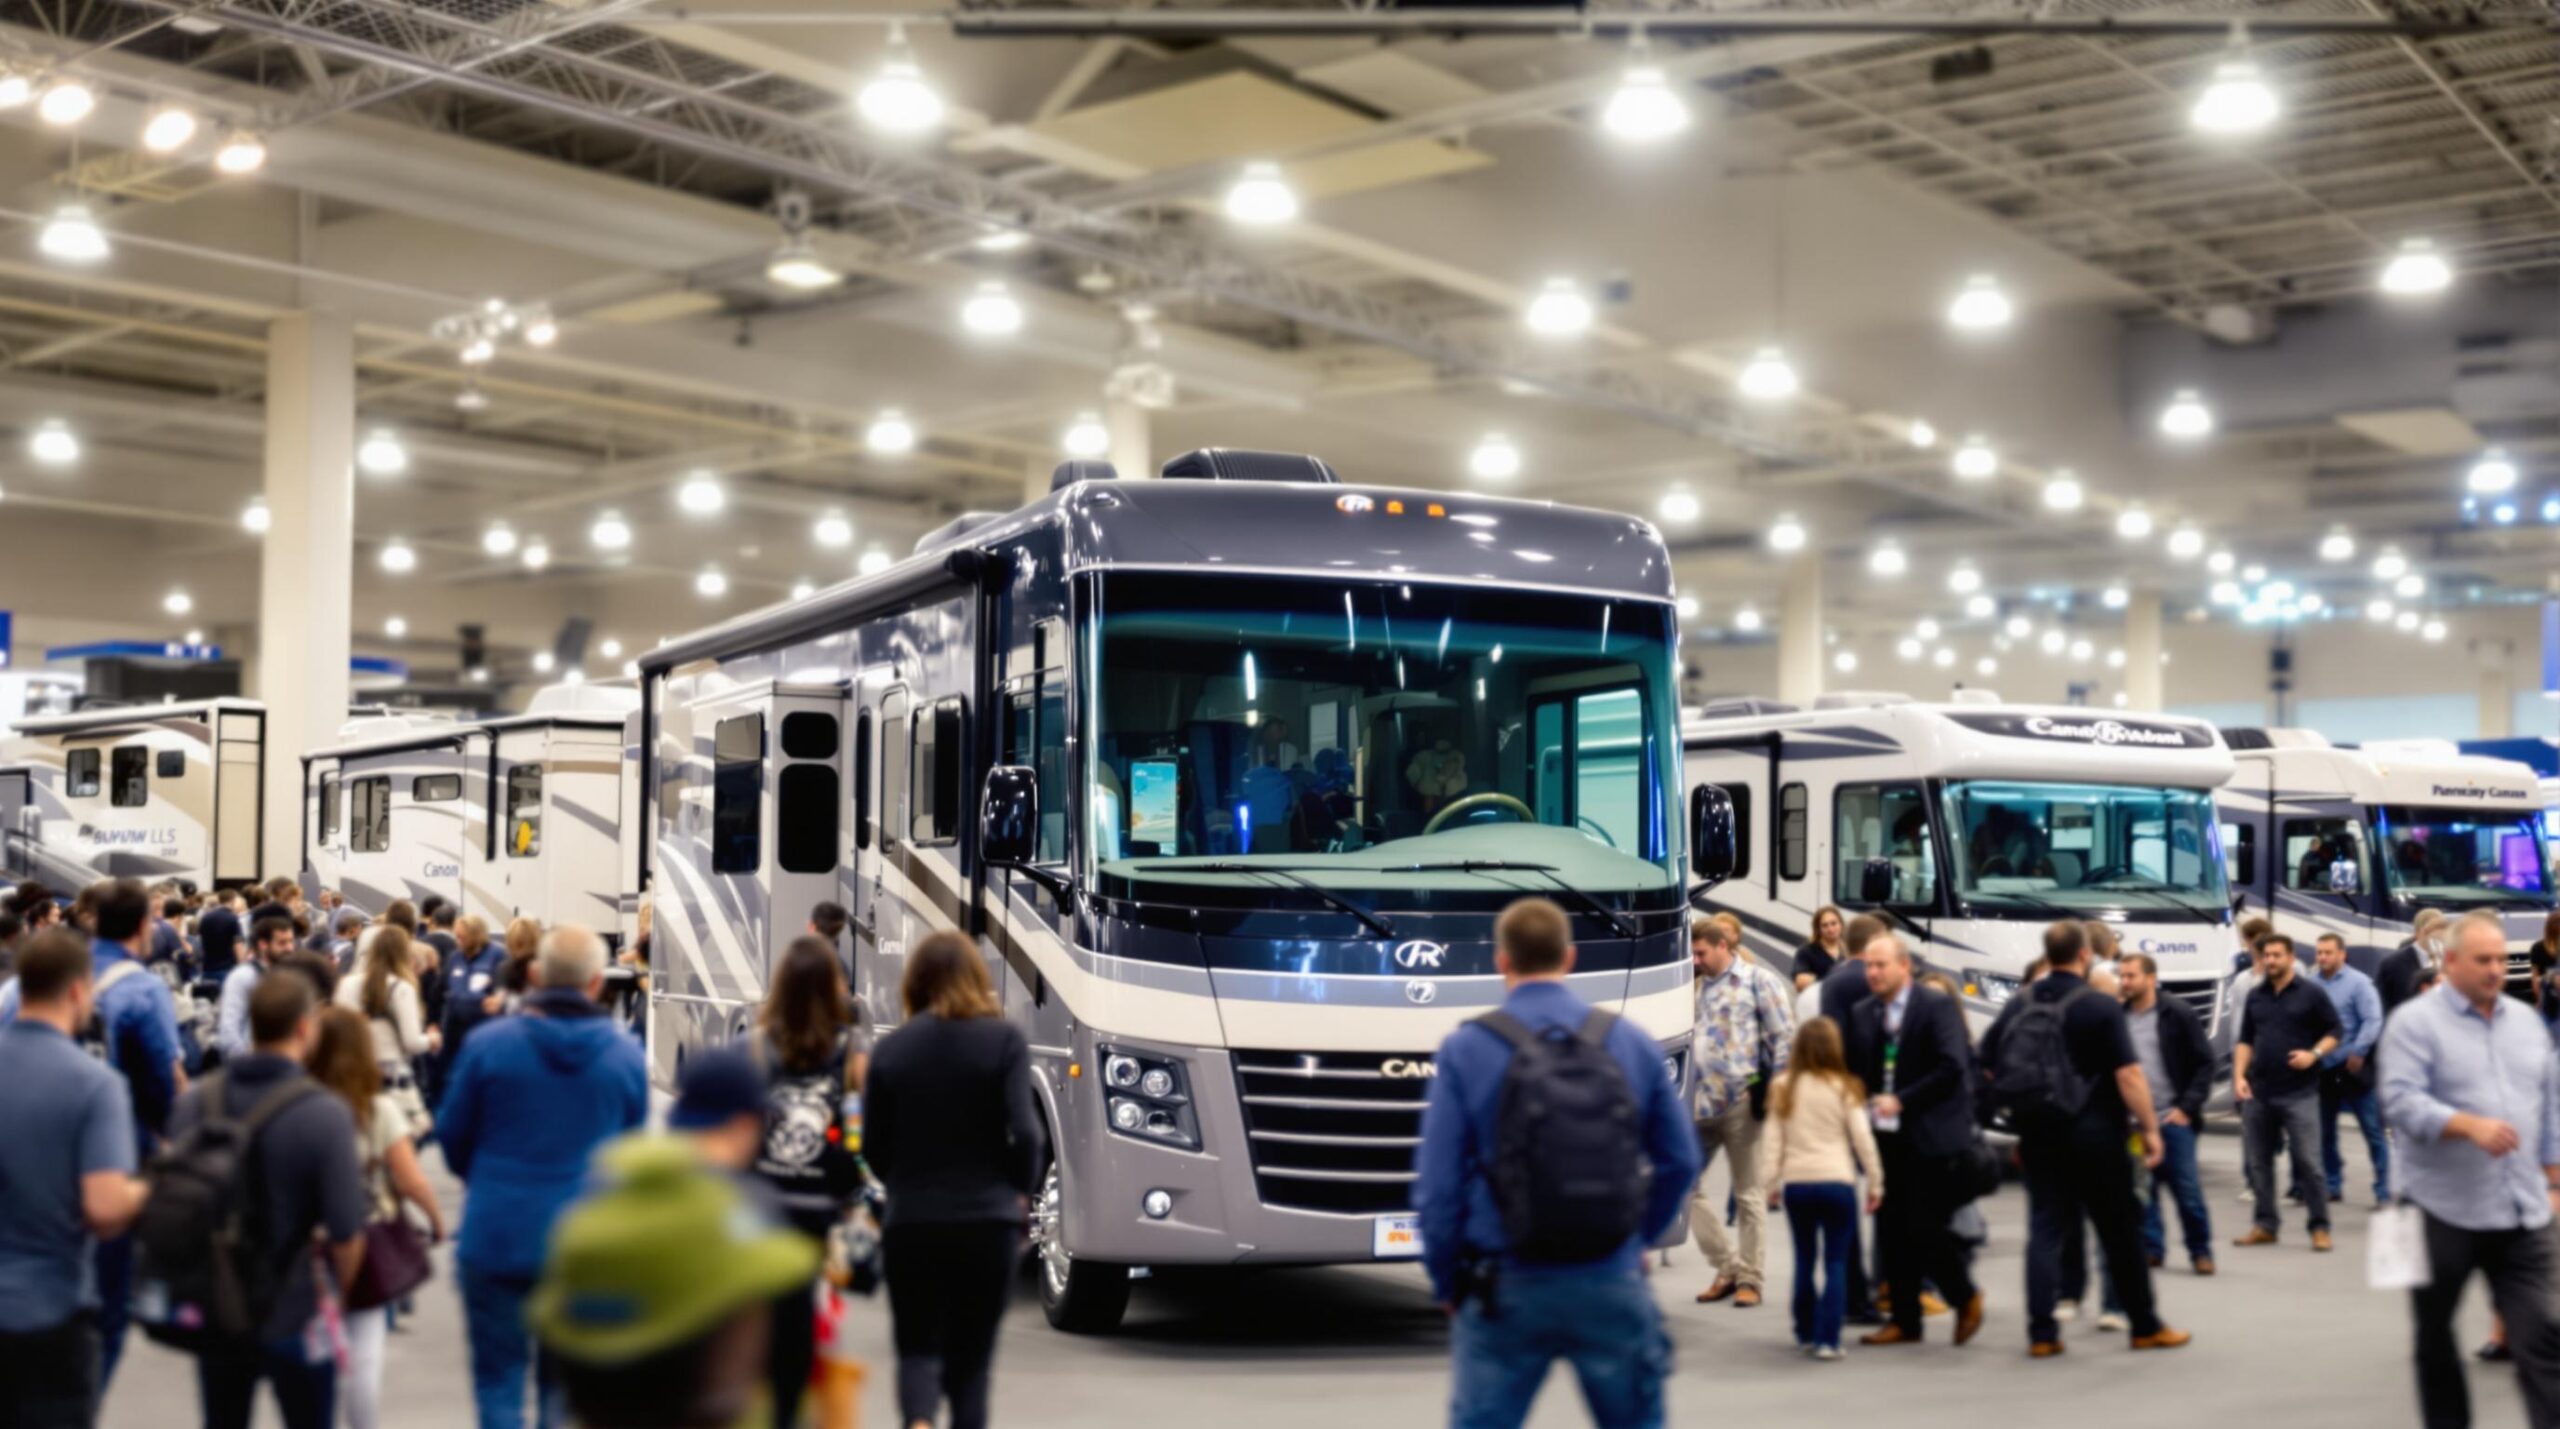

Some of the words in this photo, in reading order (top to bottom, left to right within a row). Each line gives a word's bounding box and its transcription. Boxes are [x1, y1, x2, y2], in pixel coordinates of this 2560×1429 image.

[423, 860, 459, 878] Canon
[2138, 938, 2198, 955] Canon
[1381, 1058, 1438, 1078] CAN
